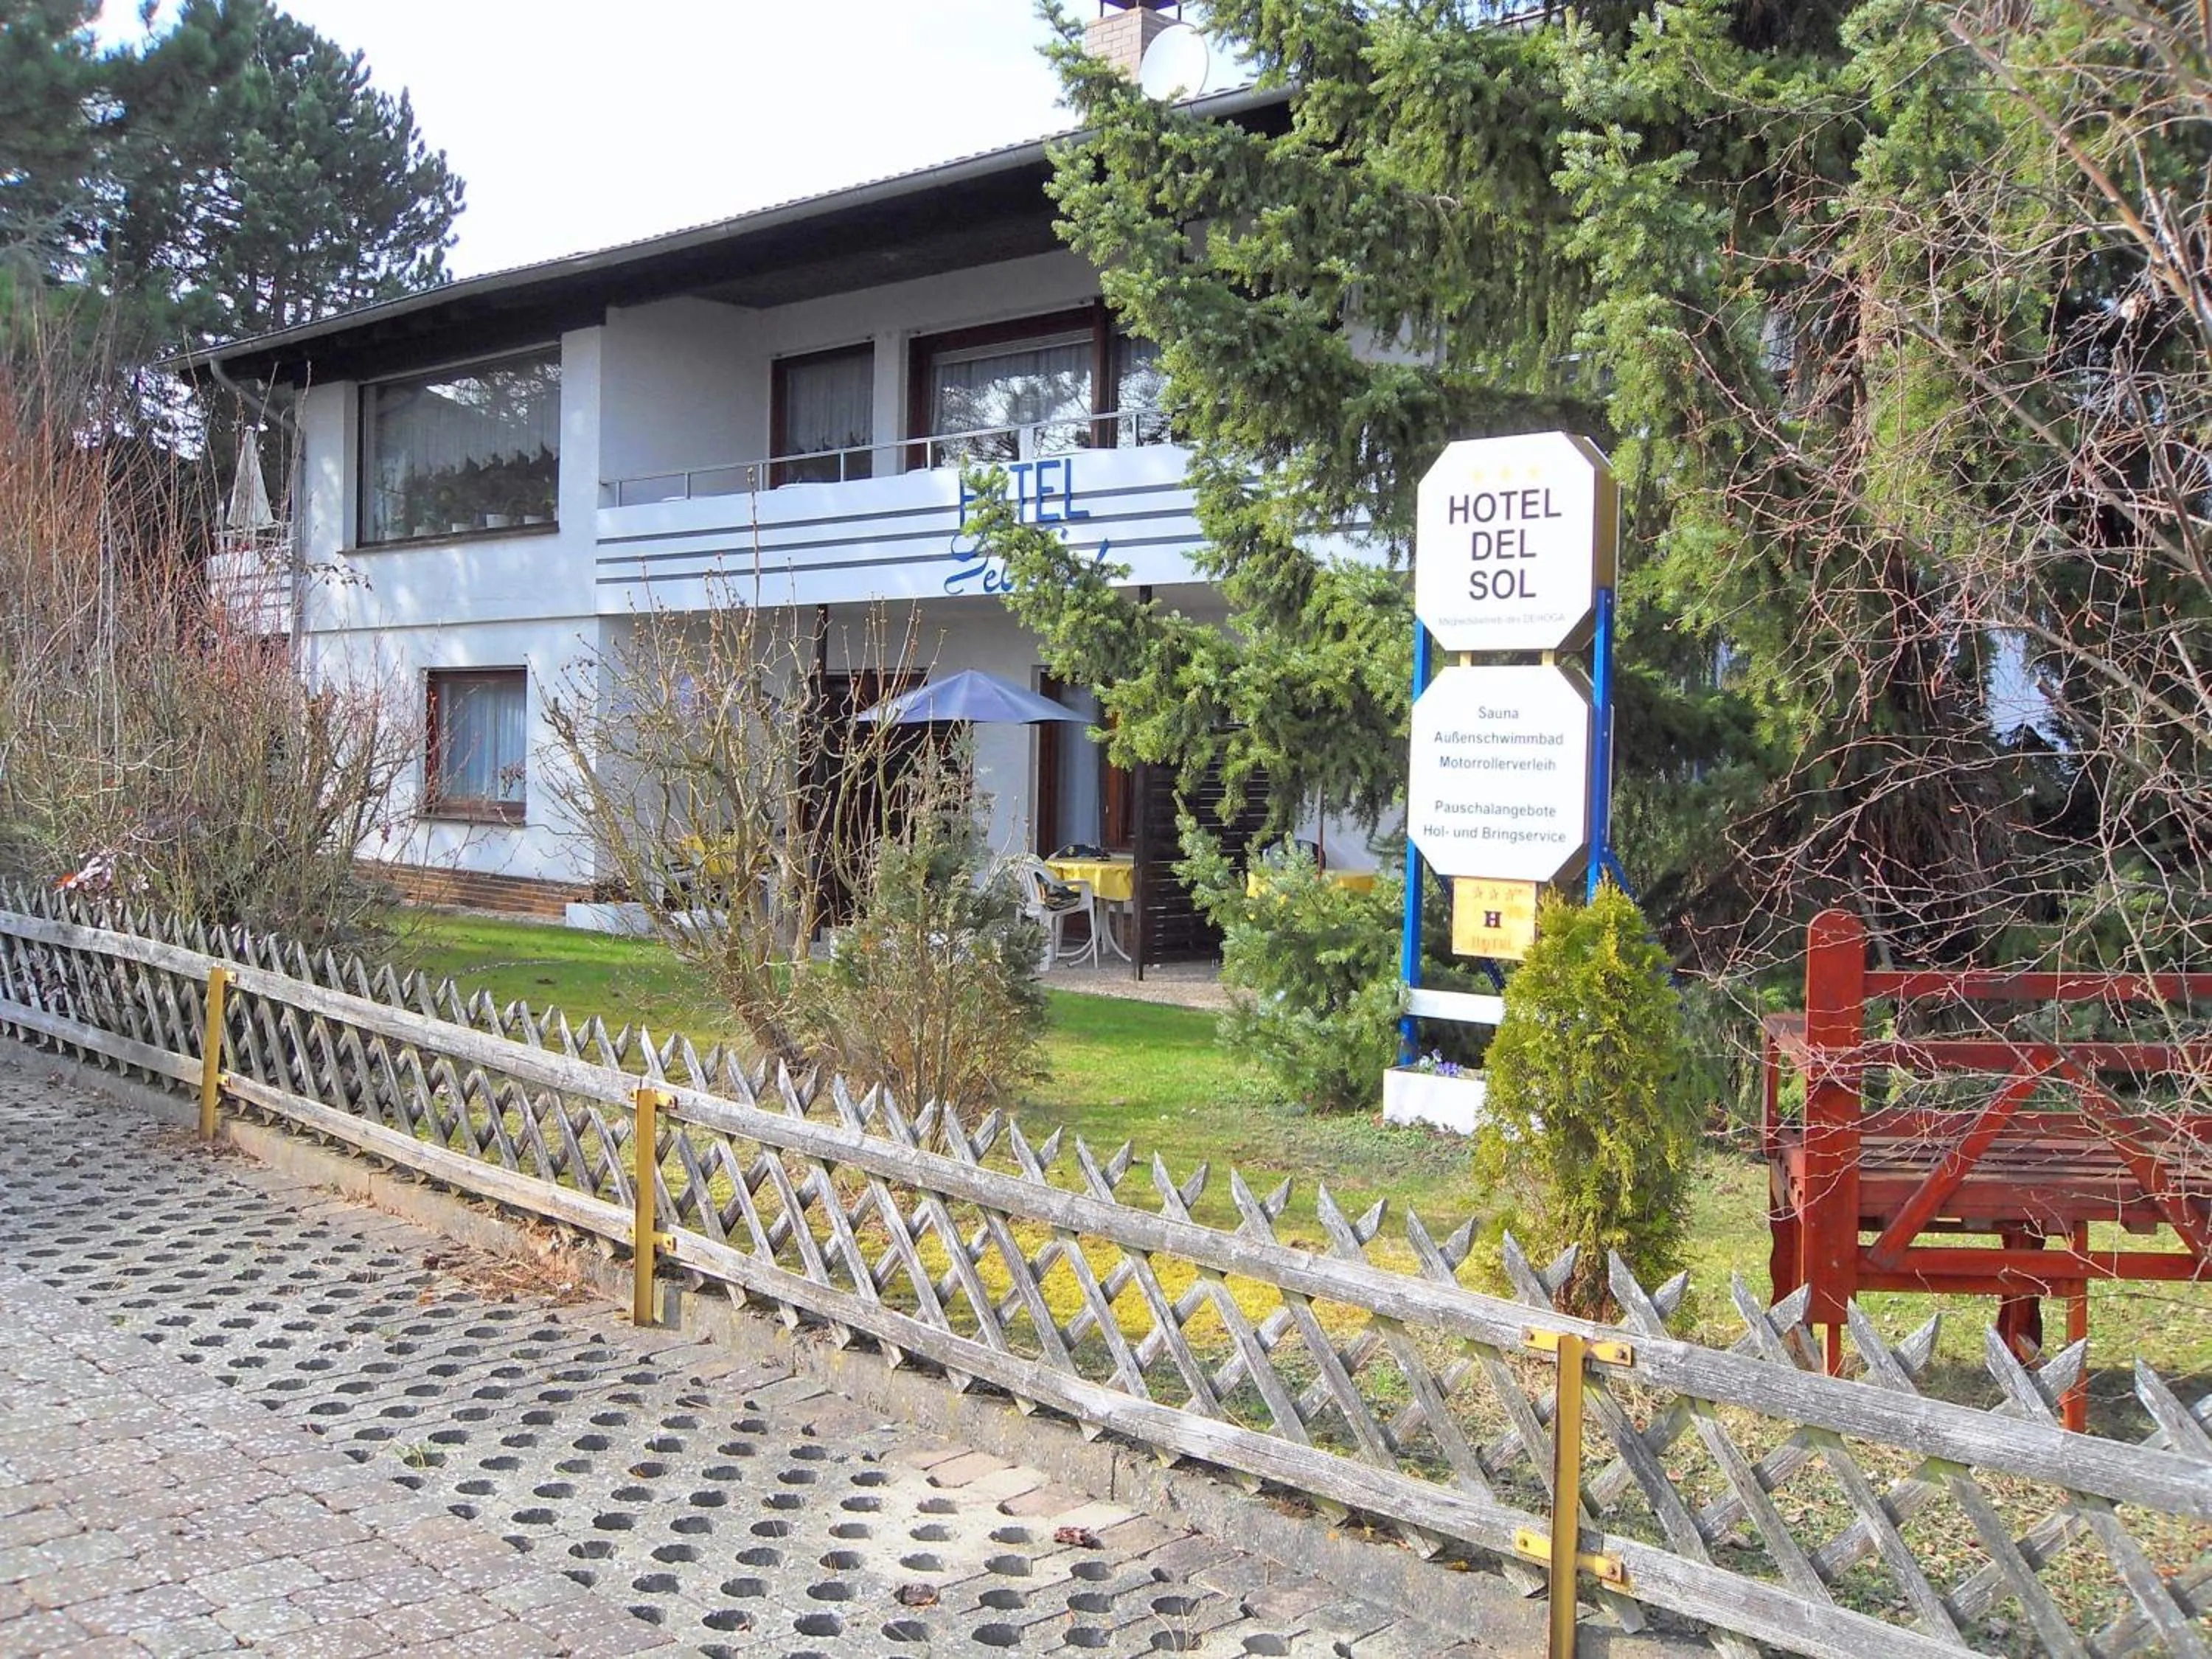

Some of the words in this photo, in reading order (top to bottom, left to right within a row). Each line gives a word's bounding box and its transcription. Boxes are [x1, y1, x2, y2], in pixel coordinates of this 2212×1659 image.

[959, 458, 1089, 528] HTEL
[1449, 488, 1562, 524] HOTEL
[1471, 529, 1537, 560] DEL
[1469, 568, 1537, 600] SOL
[1478, 706, 1519, 719] Sauna
[1434, 731, 1564, 745] Außenschwimmbad
[1439, 756, 1557, 771] Motorrollerverleih
[1435, 800, 1557, 818] Pauschalangebote
[1423, 824, 1450, 837] Hol-
[1453, 827, 1478, 838] und
[1481, 827, 1566, 844] Bringservice
[1484, 911, 1503, 928] H
